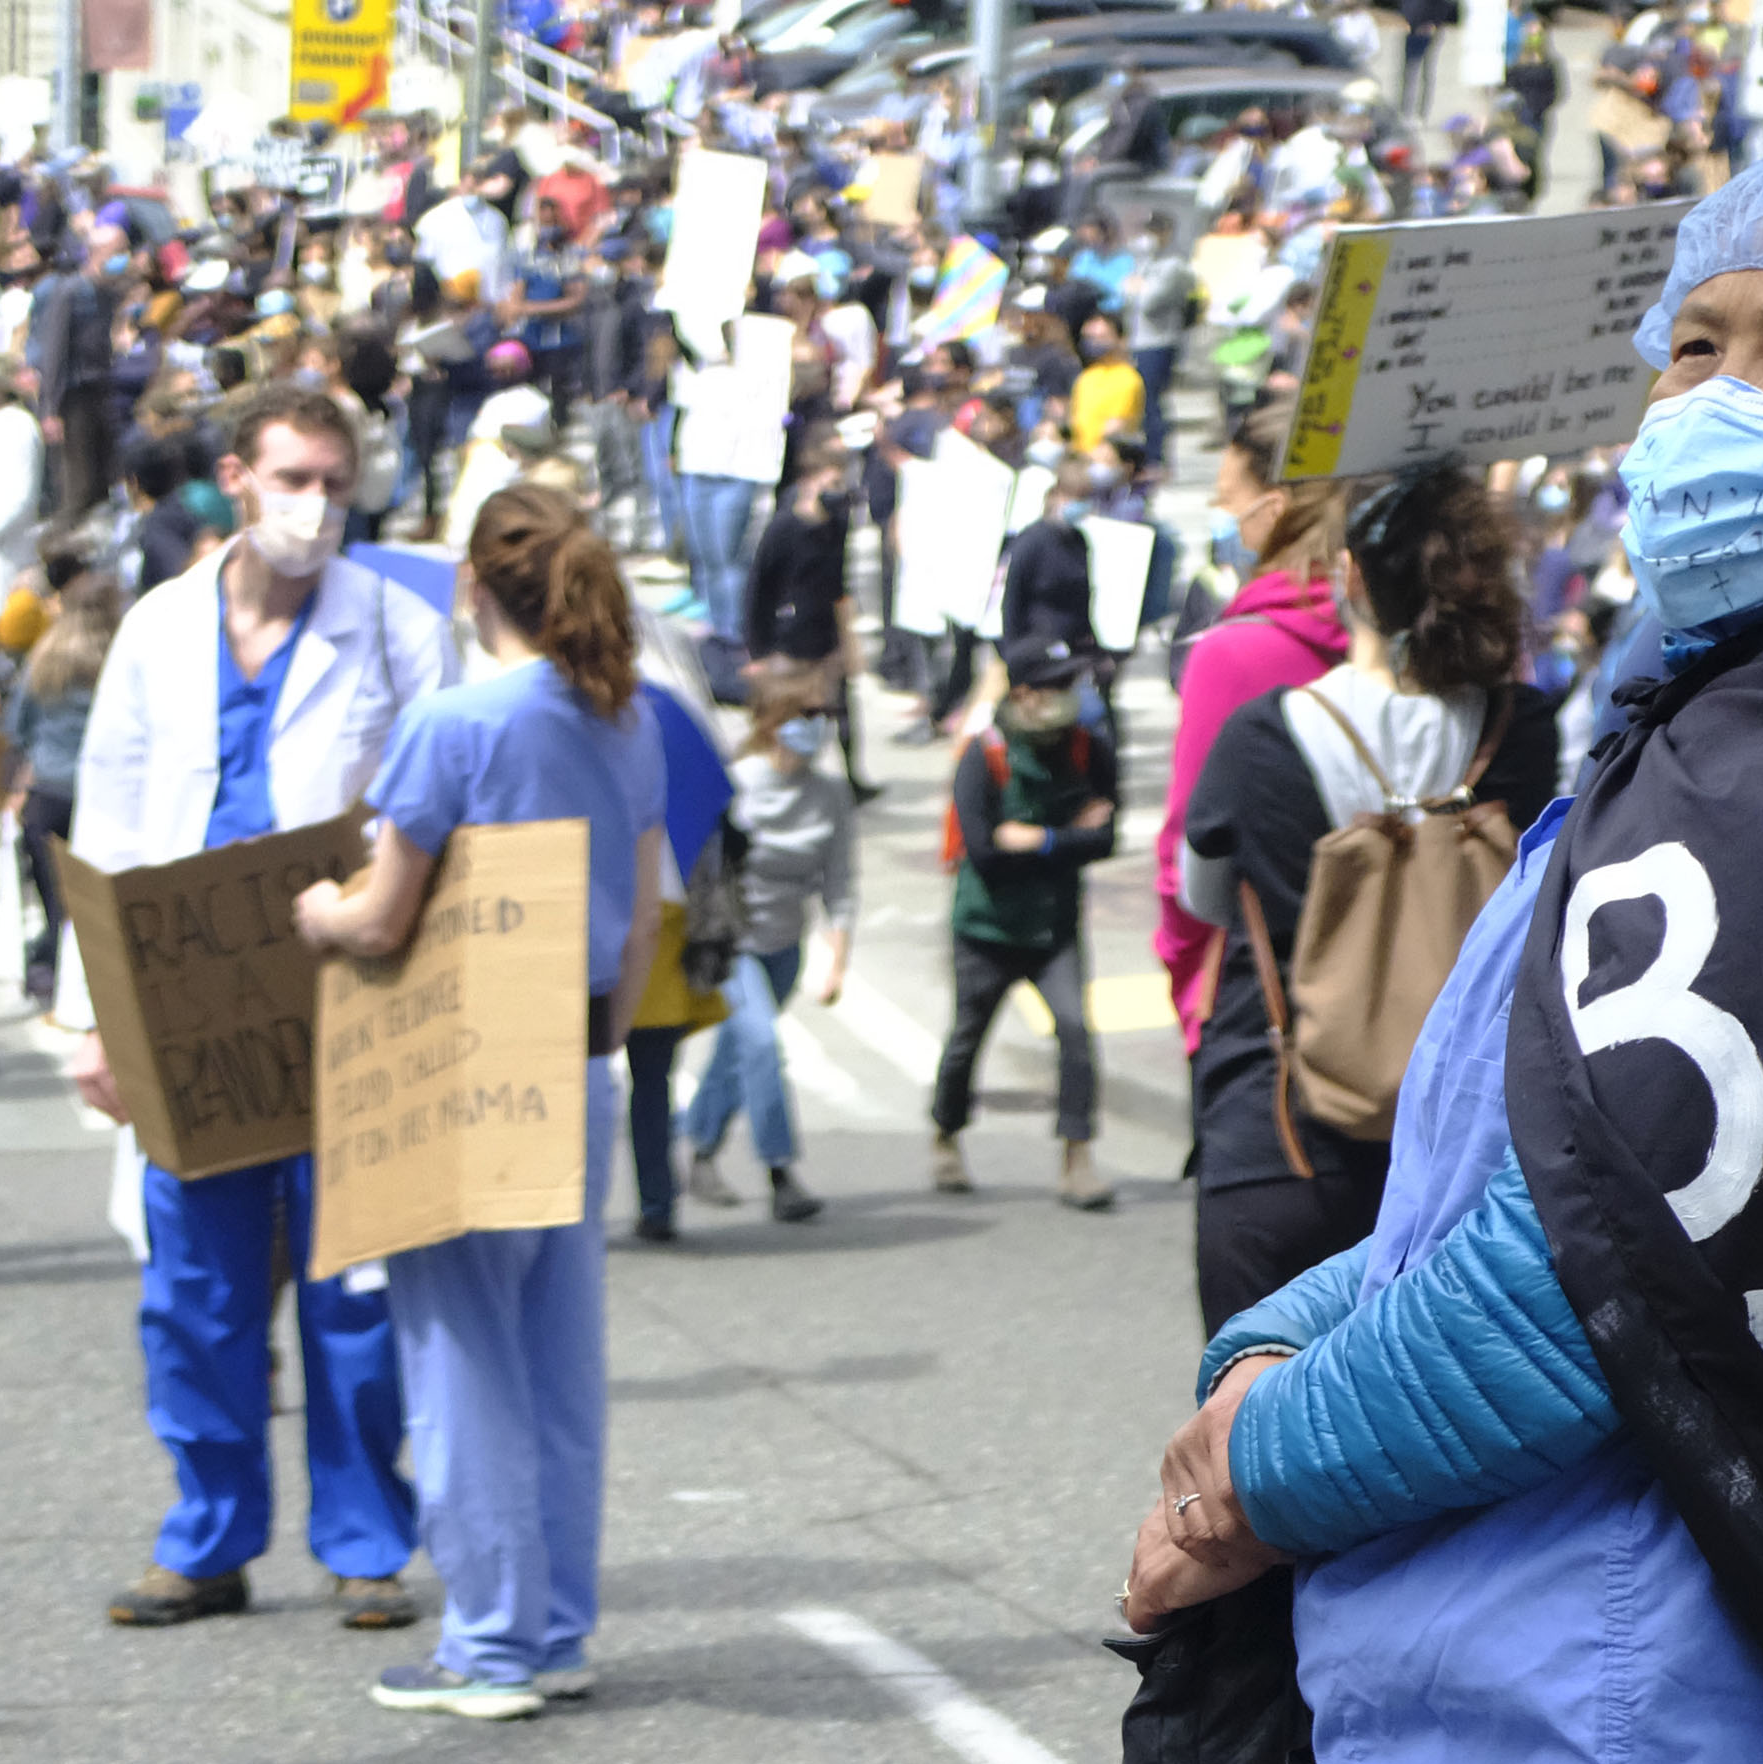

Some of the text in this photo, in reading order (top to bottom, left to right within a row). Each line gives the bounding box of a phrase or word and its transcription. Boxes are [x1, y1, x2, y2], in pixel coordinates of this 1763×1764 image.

[1407, 364, 1635, 418] You could be me
[1405, 423, 1444, 451] I
[1461, 410, 1540, 444] could
[1581, 405, 1616, 432] you
[436, 1082, 549, 1137] MAMA
